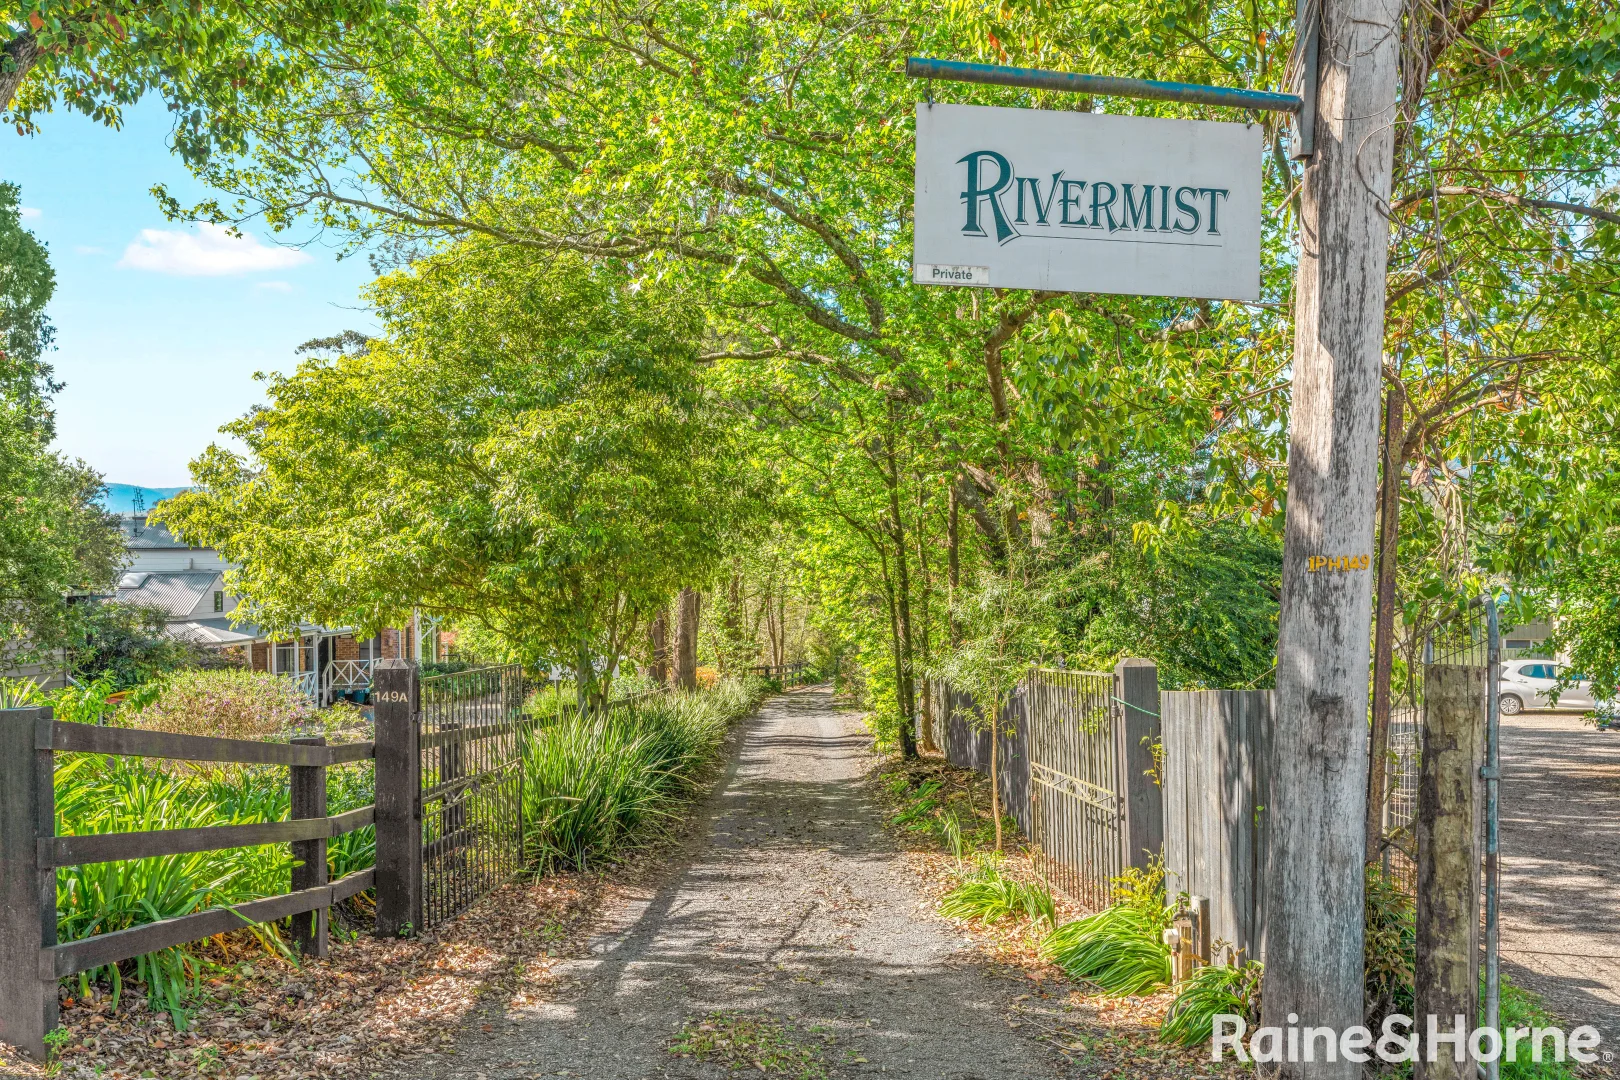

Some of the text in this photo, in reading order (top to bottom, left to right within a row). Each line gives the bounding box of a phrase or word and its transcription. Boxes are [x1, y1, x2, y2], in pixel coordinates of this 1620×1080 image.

[932, 268, 973, 280] Private
[1308, 554, 1371, 572] 1PH149
[374, 690, 409, 703] 149A
